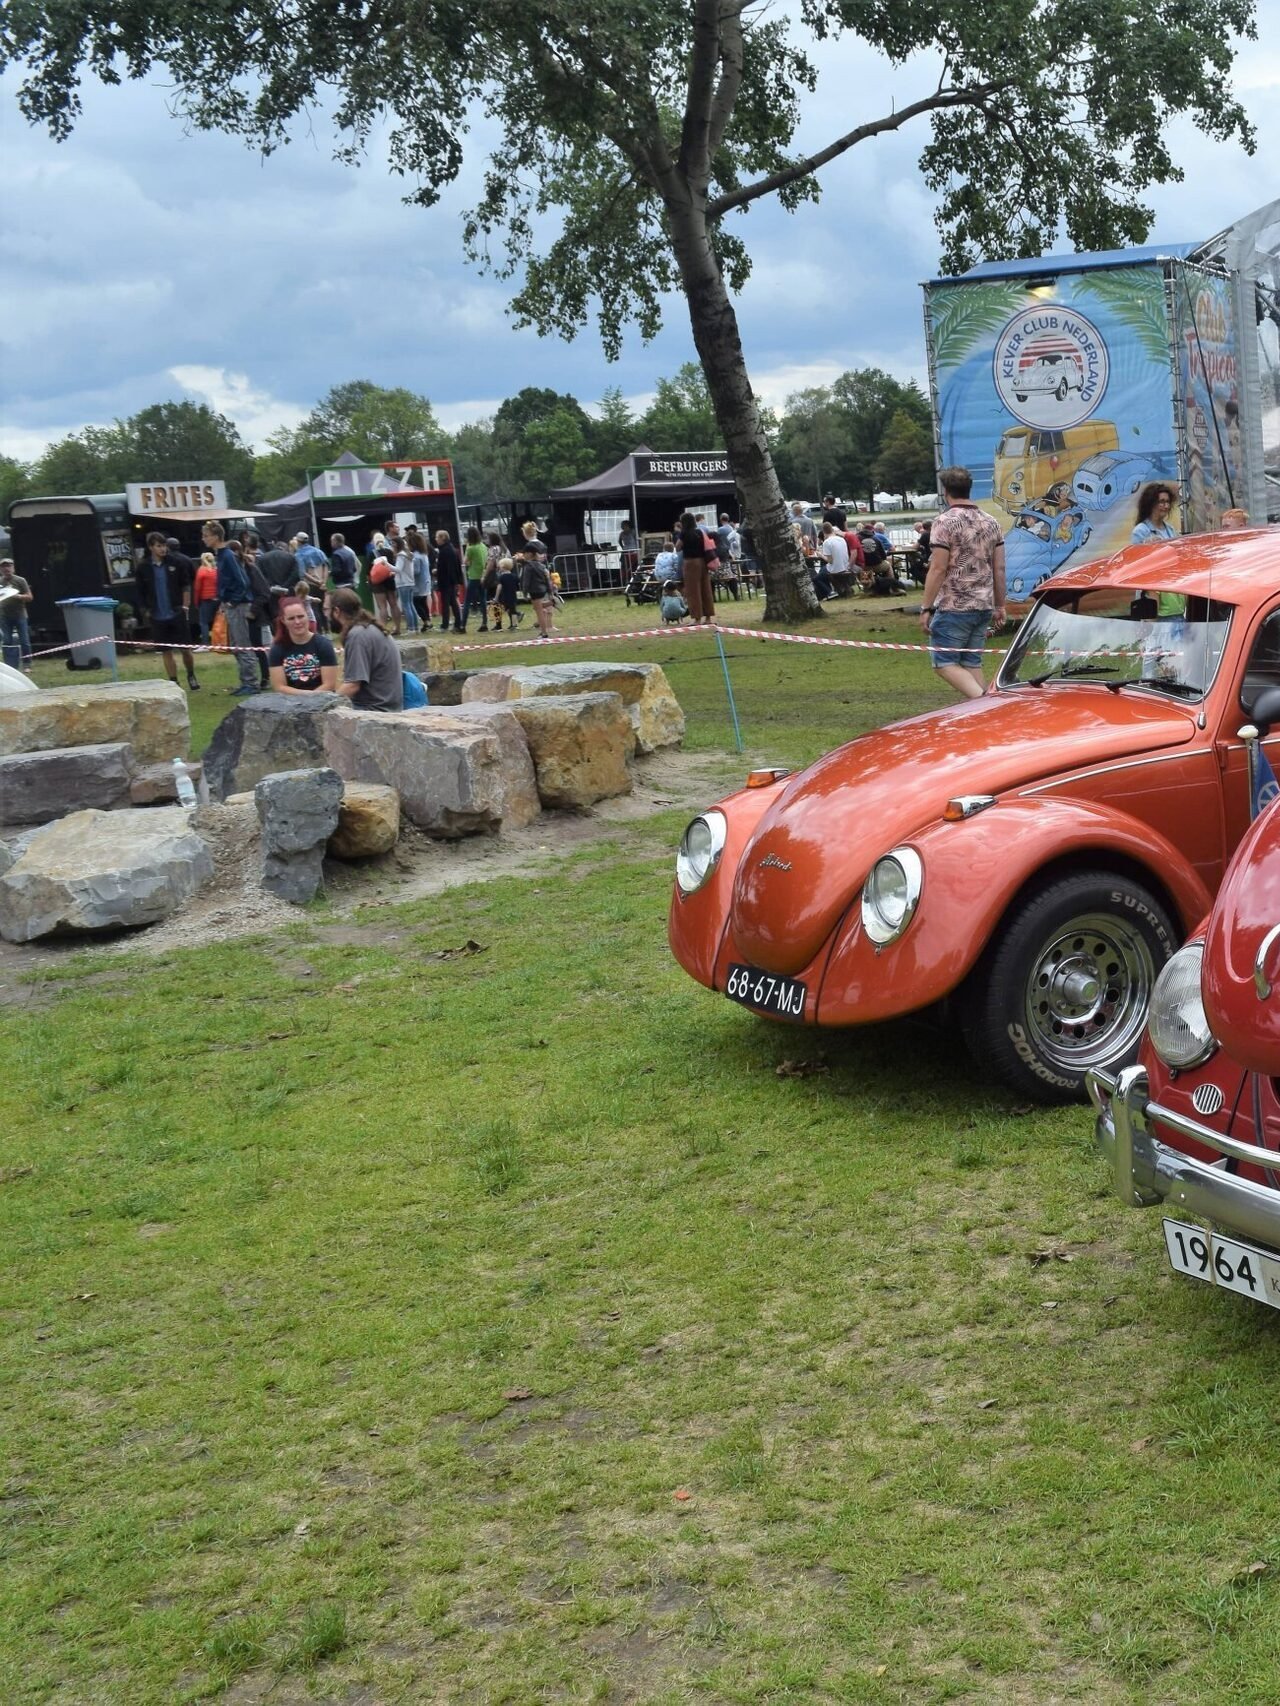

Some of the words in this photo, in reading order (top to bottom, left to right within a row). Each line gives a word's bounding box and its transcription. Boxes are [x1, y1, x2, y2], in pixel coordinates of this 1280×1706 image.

[1003, 333, 1024, 378] KEVER
[1023, 317, 1059, 335] CLUB
[1062, 320, 1099, 402] NEDERLAND
[324, 466, 440, 497] PIZZA
[649, 460, 728, 472] BEEFBURGERS
[140, 485, 215, 509] FRITES
[1110, 891, 1174, 960] SUPREM
[727, 968, 805, 1014] 68-67-MJ
[1174, 1231, 1257, 1292] 1964
